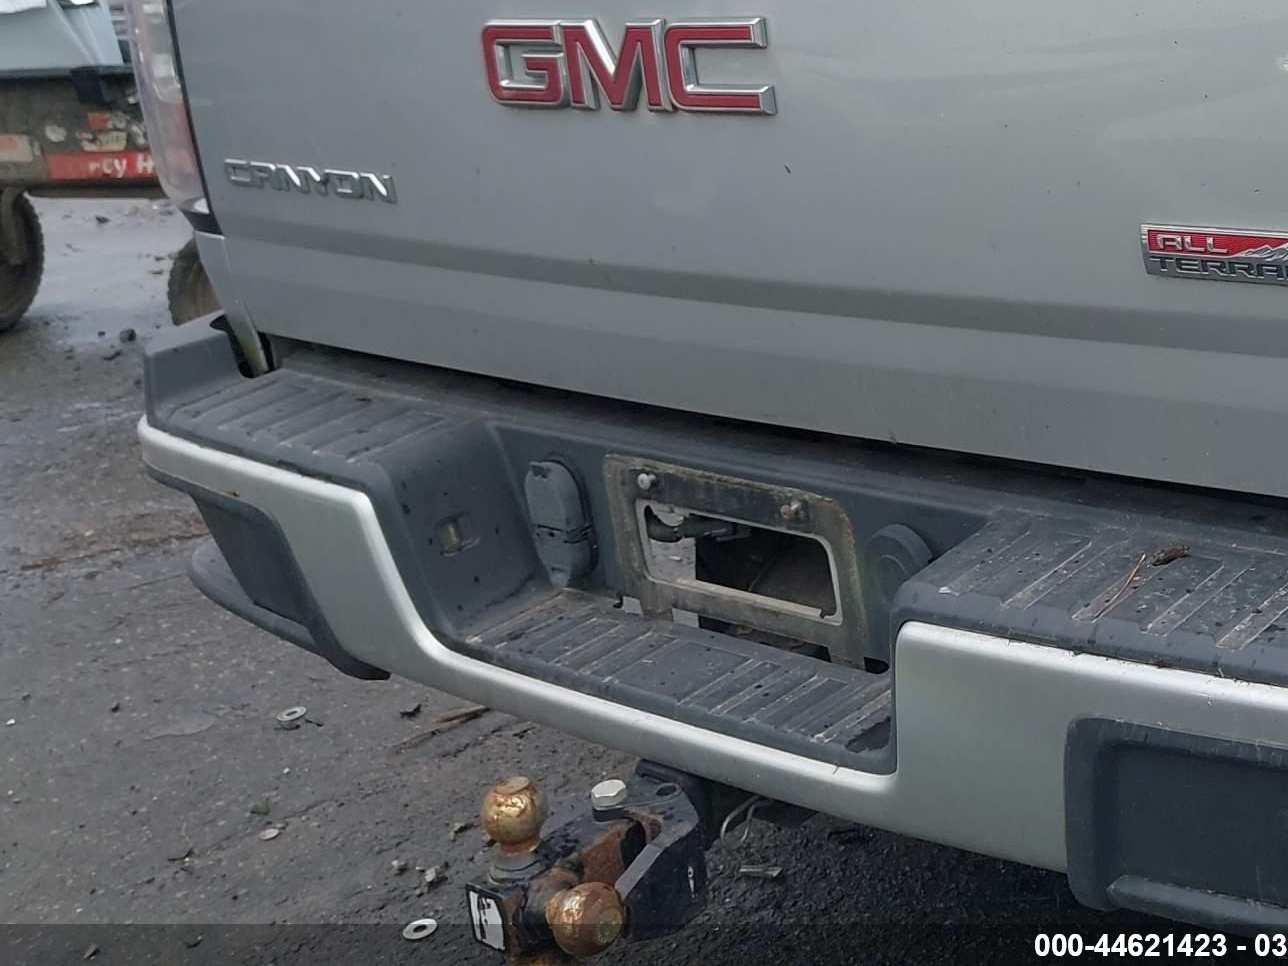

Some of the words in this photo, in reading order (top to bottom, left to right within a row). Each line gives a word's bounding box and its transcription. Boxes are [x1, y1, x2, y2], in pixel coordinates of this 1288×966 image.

[481, 17, 777, 115] GMC
[224, 158, 398, 205] CANYON
[1155, 233, 1230, 254] ALL
